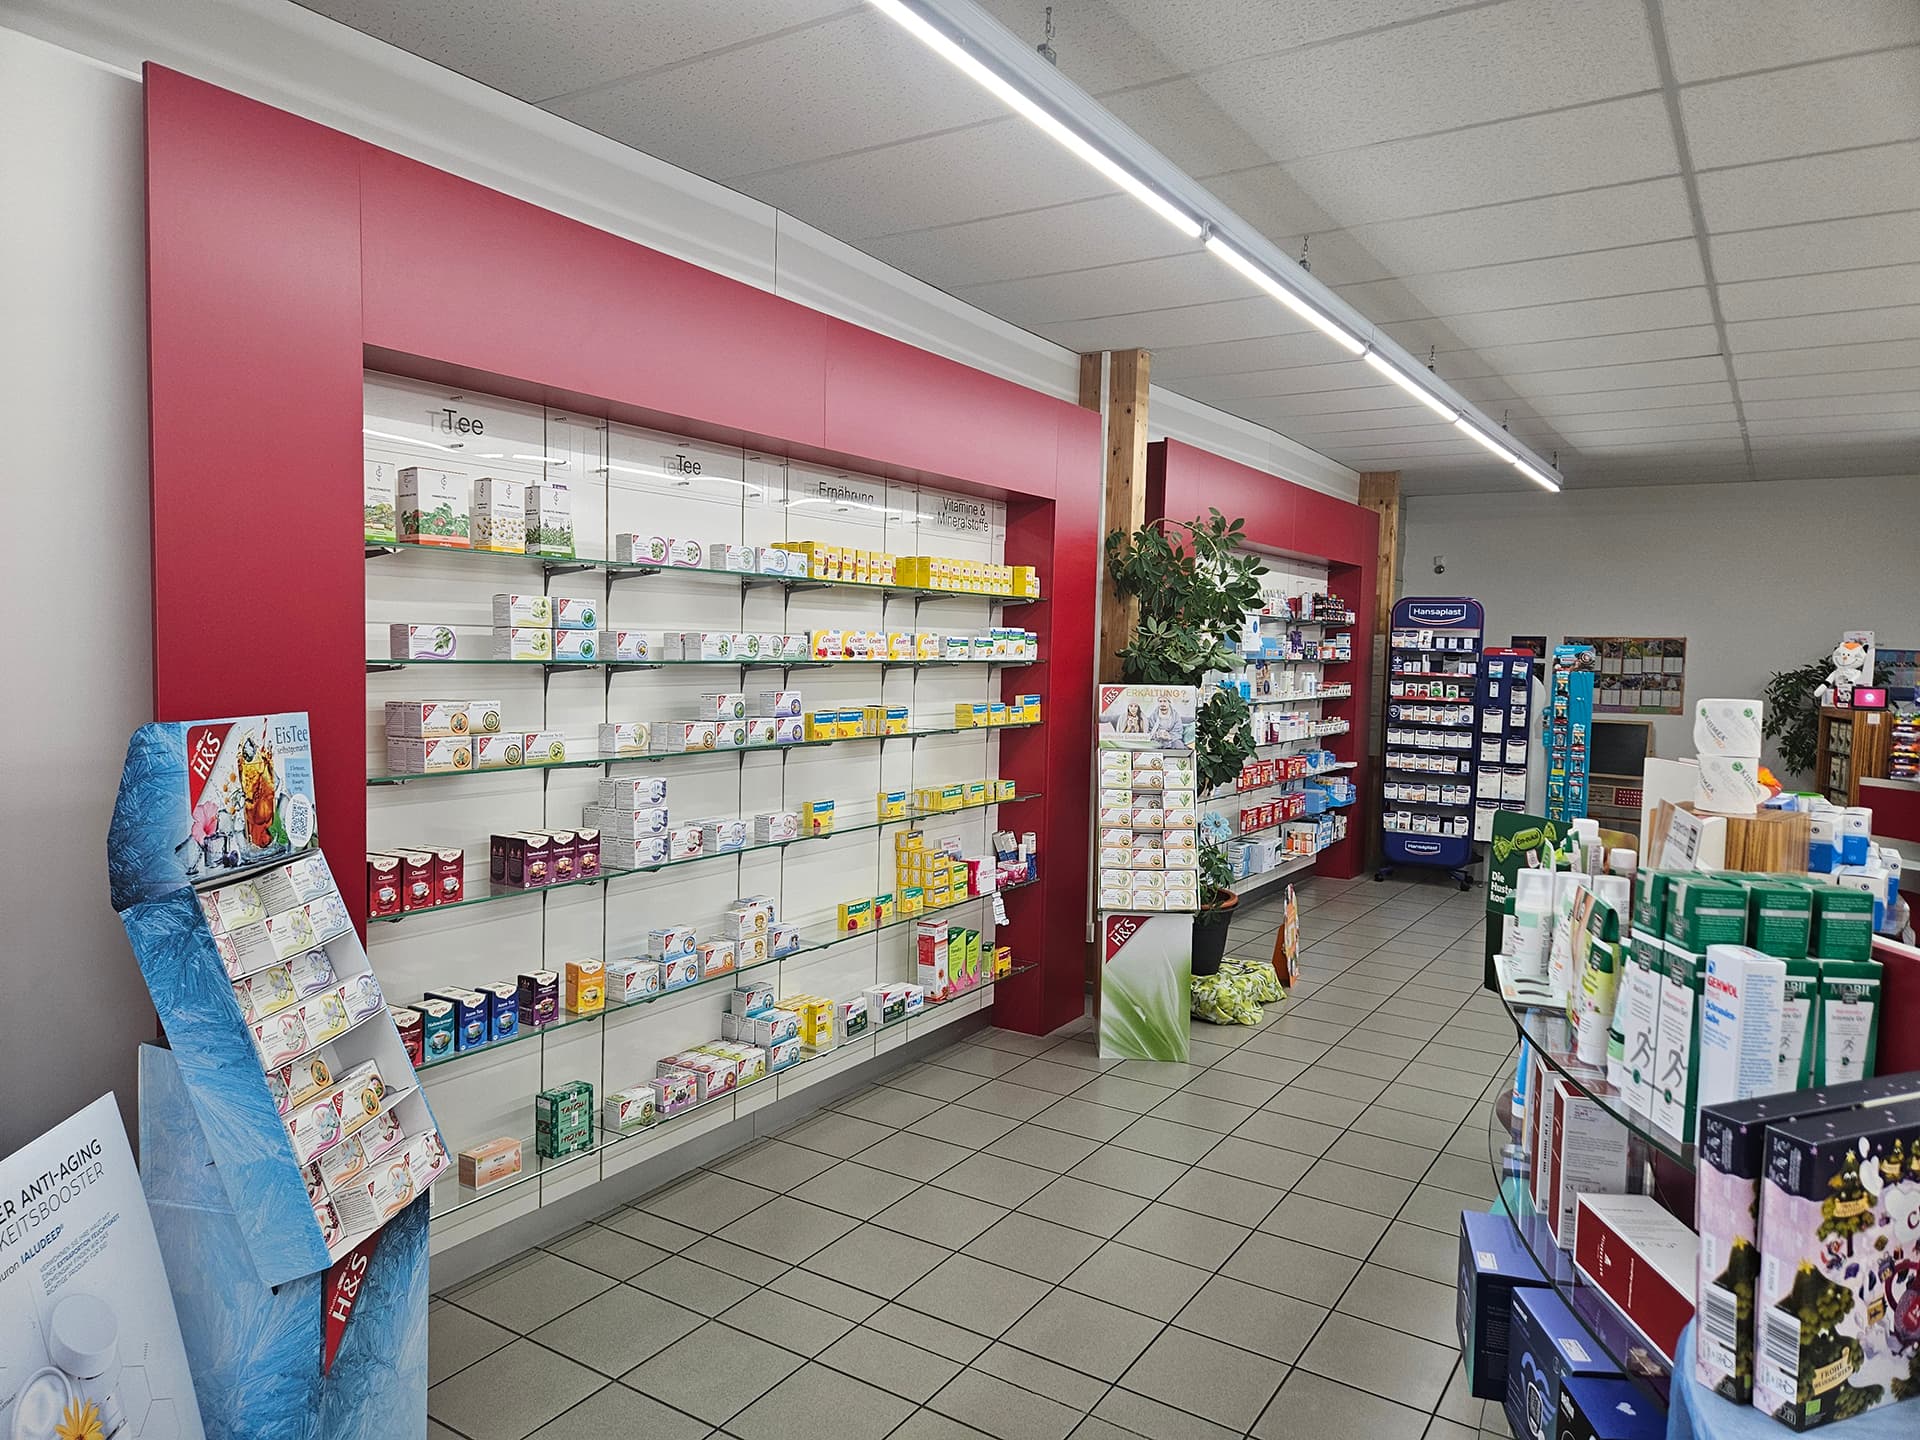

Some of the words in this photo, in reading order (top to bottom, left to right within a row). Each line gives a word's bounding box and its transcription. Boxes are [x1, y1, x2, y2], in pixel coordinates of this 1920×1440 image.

[442, 408, 484, 436] Tee
[675, 454, 701, 475] Tee
[818, 481, 874, 505] Ernährung
[942, 497, 978, 516] Vitamine
[979, 504, 986, 517] &
[937, 512, 989, 532] Mineralstoffe
[1413, 608, 1462, 617] Hansaplast
[1104, 688, 1119, 705] H&S
[275, 725, 308, 745] EisTee
[193, 732, 221, 780] H&S
[1491, 871, 1505, 883] Die
[1490, 881, 1513, 894] Huste
[1490, 891, 1505, 903] kom
[1110, 919, 1137, 947] H&S
[1707, 976, 1738, 999] GEHWOL
[1830, 984, 1871, 997] MOBIL
[21, 1139, 102, 1208] ANTI-AGING
[0, 1162, 105, 1252] KEITSBOOSTER
[0, 1261, 20, 1283] uron
[332, 1252, 368, 1322] H&S
[1820, 1363, 1843, 1379] FROHE
